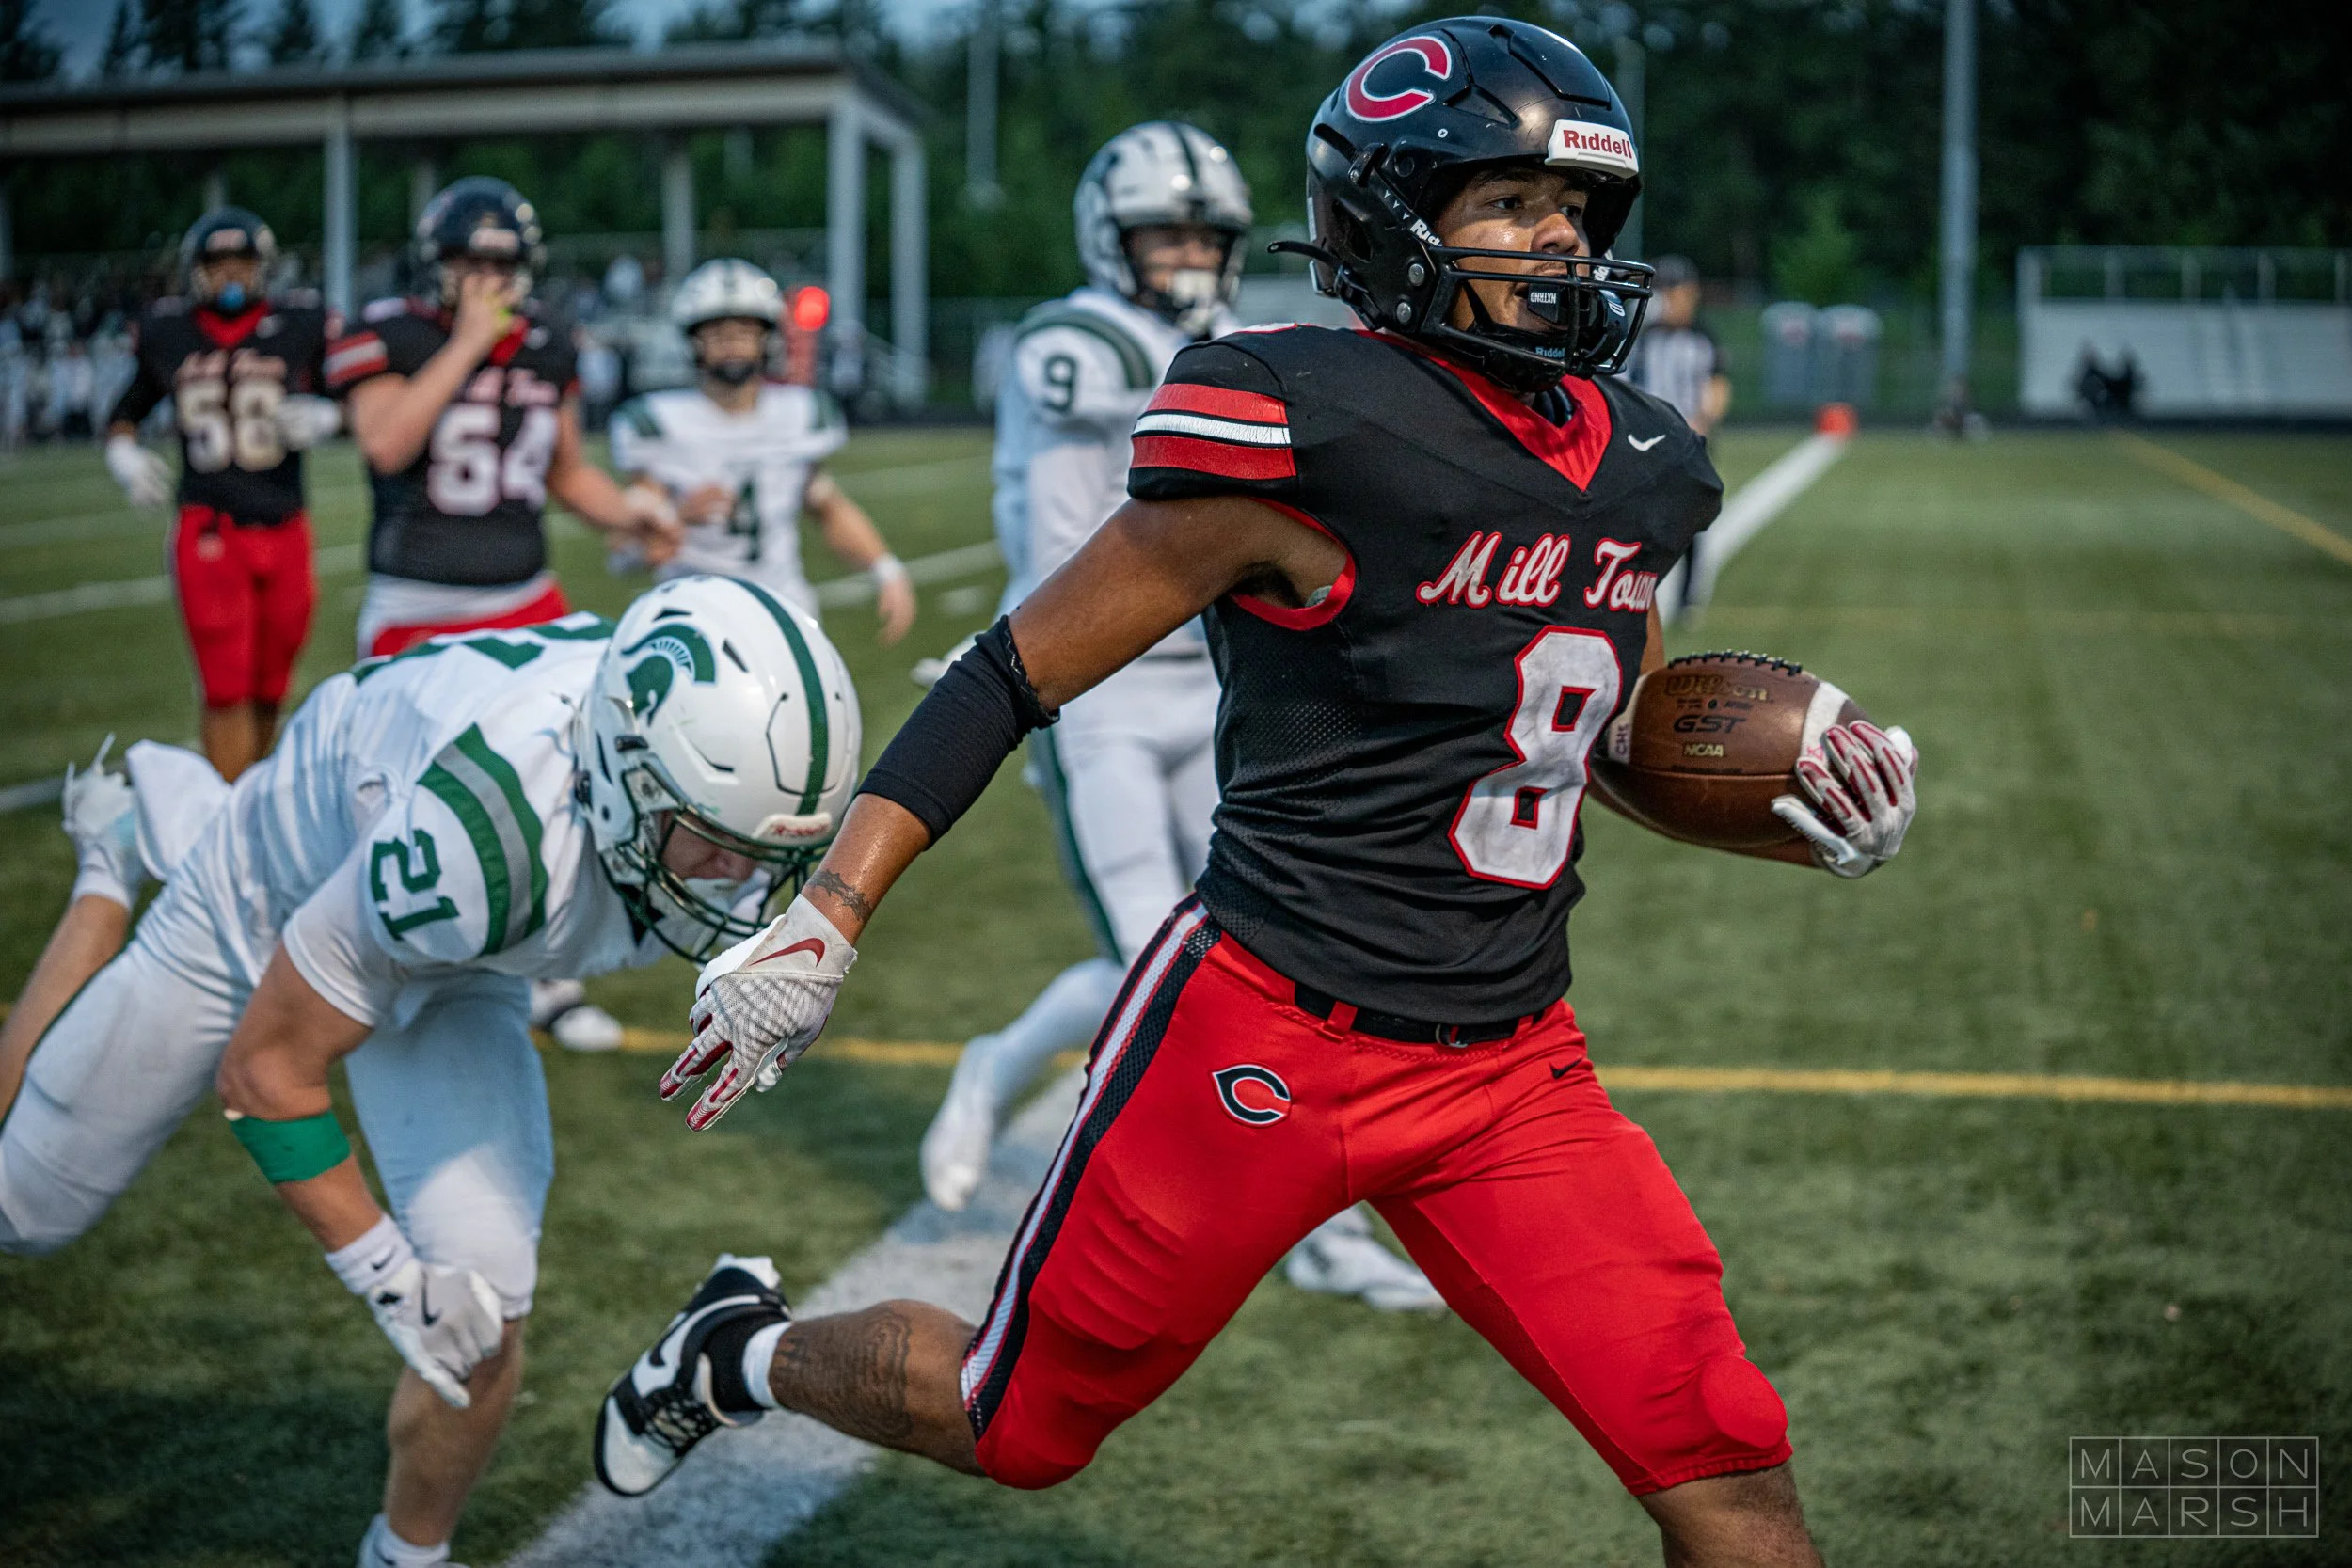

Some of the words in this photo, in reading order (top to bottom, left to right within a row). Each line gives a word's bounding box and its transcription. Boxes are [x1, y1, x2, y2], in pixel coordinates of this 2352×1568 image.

[1563, 129, 1632, 159] Riddell
[1530, 292, 1557, 304] NXTRND
[1044, 353, 1076, 413] 9
[726, 472, 761, 562] 4
[1415, 531, 1571, 609] Mill
[1674, 714, 1746, 734] GST
[1683, 743, 1724, 757] NCAA
[1447, 625, 1623, 890] 8
[371, 829, 461, 942] 21
